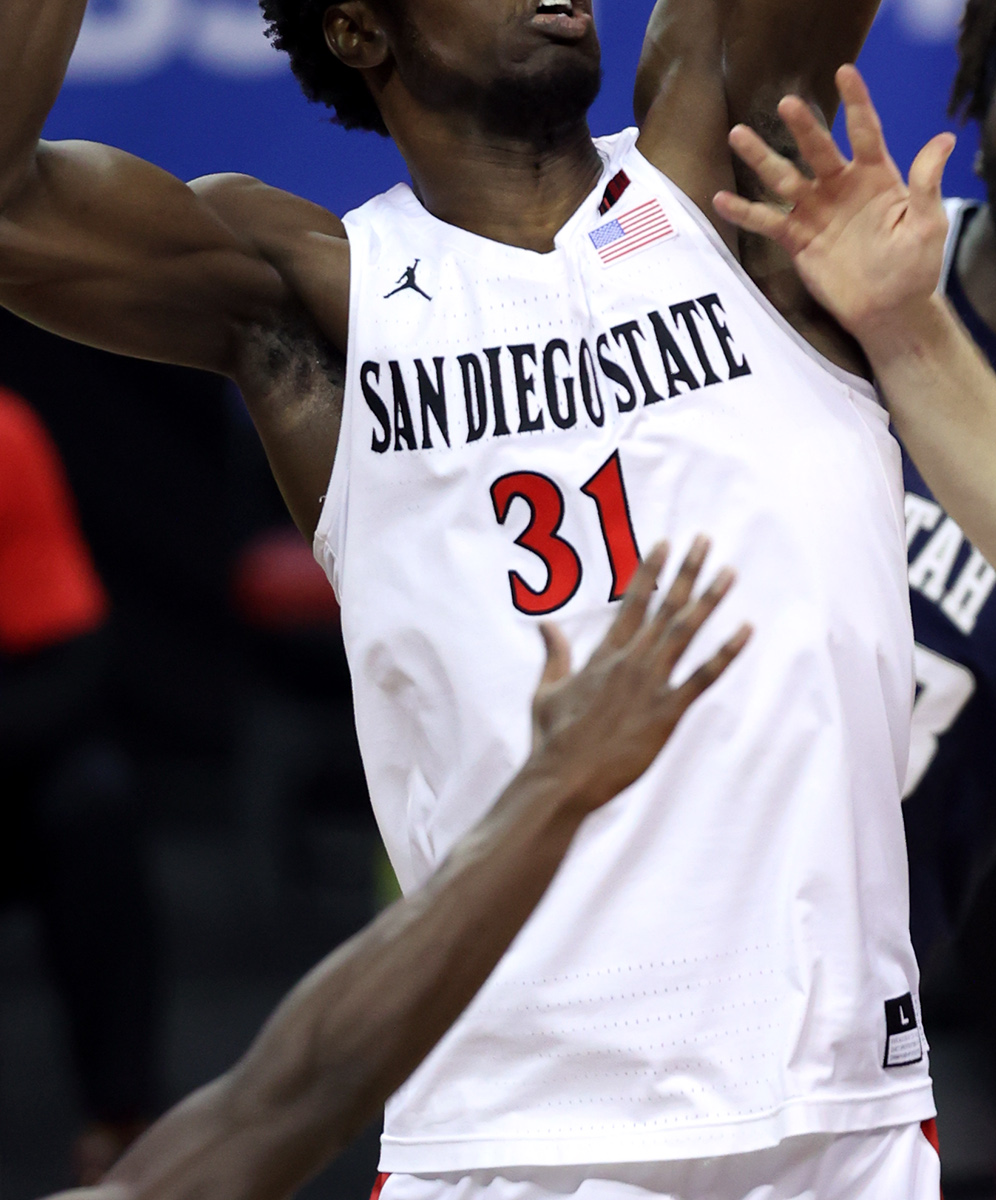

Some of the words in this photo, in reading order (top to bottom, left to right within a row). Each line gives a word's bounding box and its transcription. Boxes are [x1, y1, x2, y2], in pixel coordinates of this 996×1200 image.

[359, 355, 451, 455] SAN
[456, 337, 606, 444] DIEGO
[600, 292, 753, 414] STATE
[489, 448, 659, 617] 31
